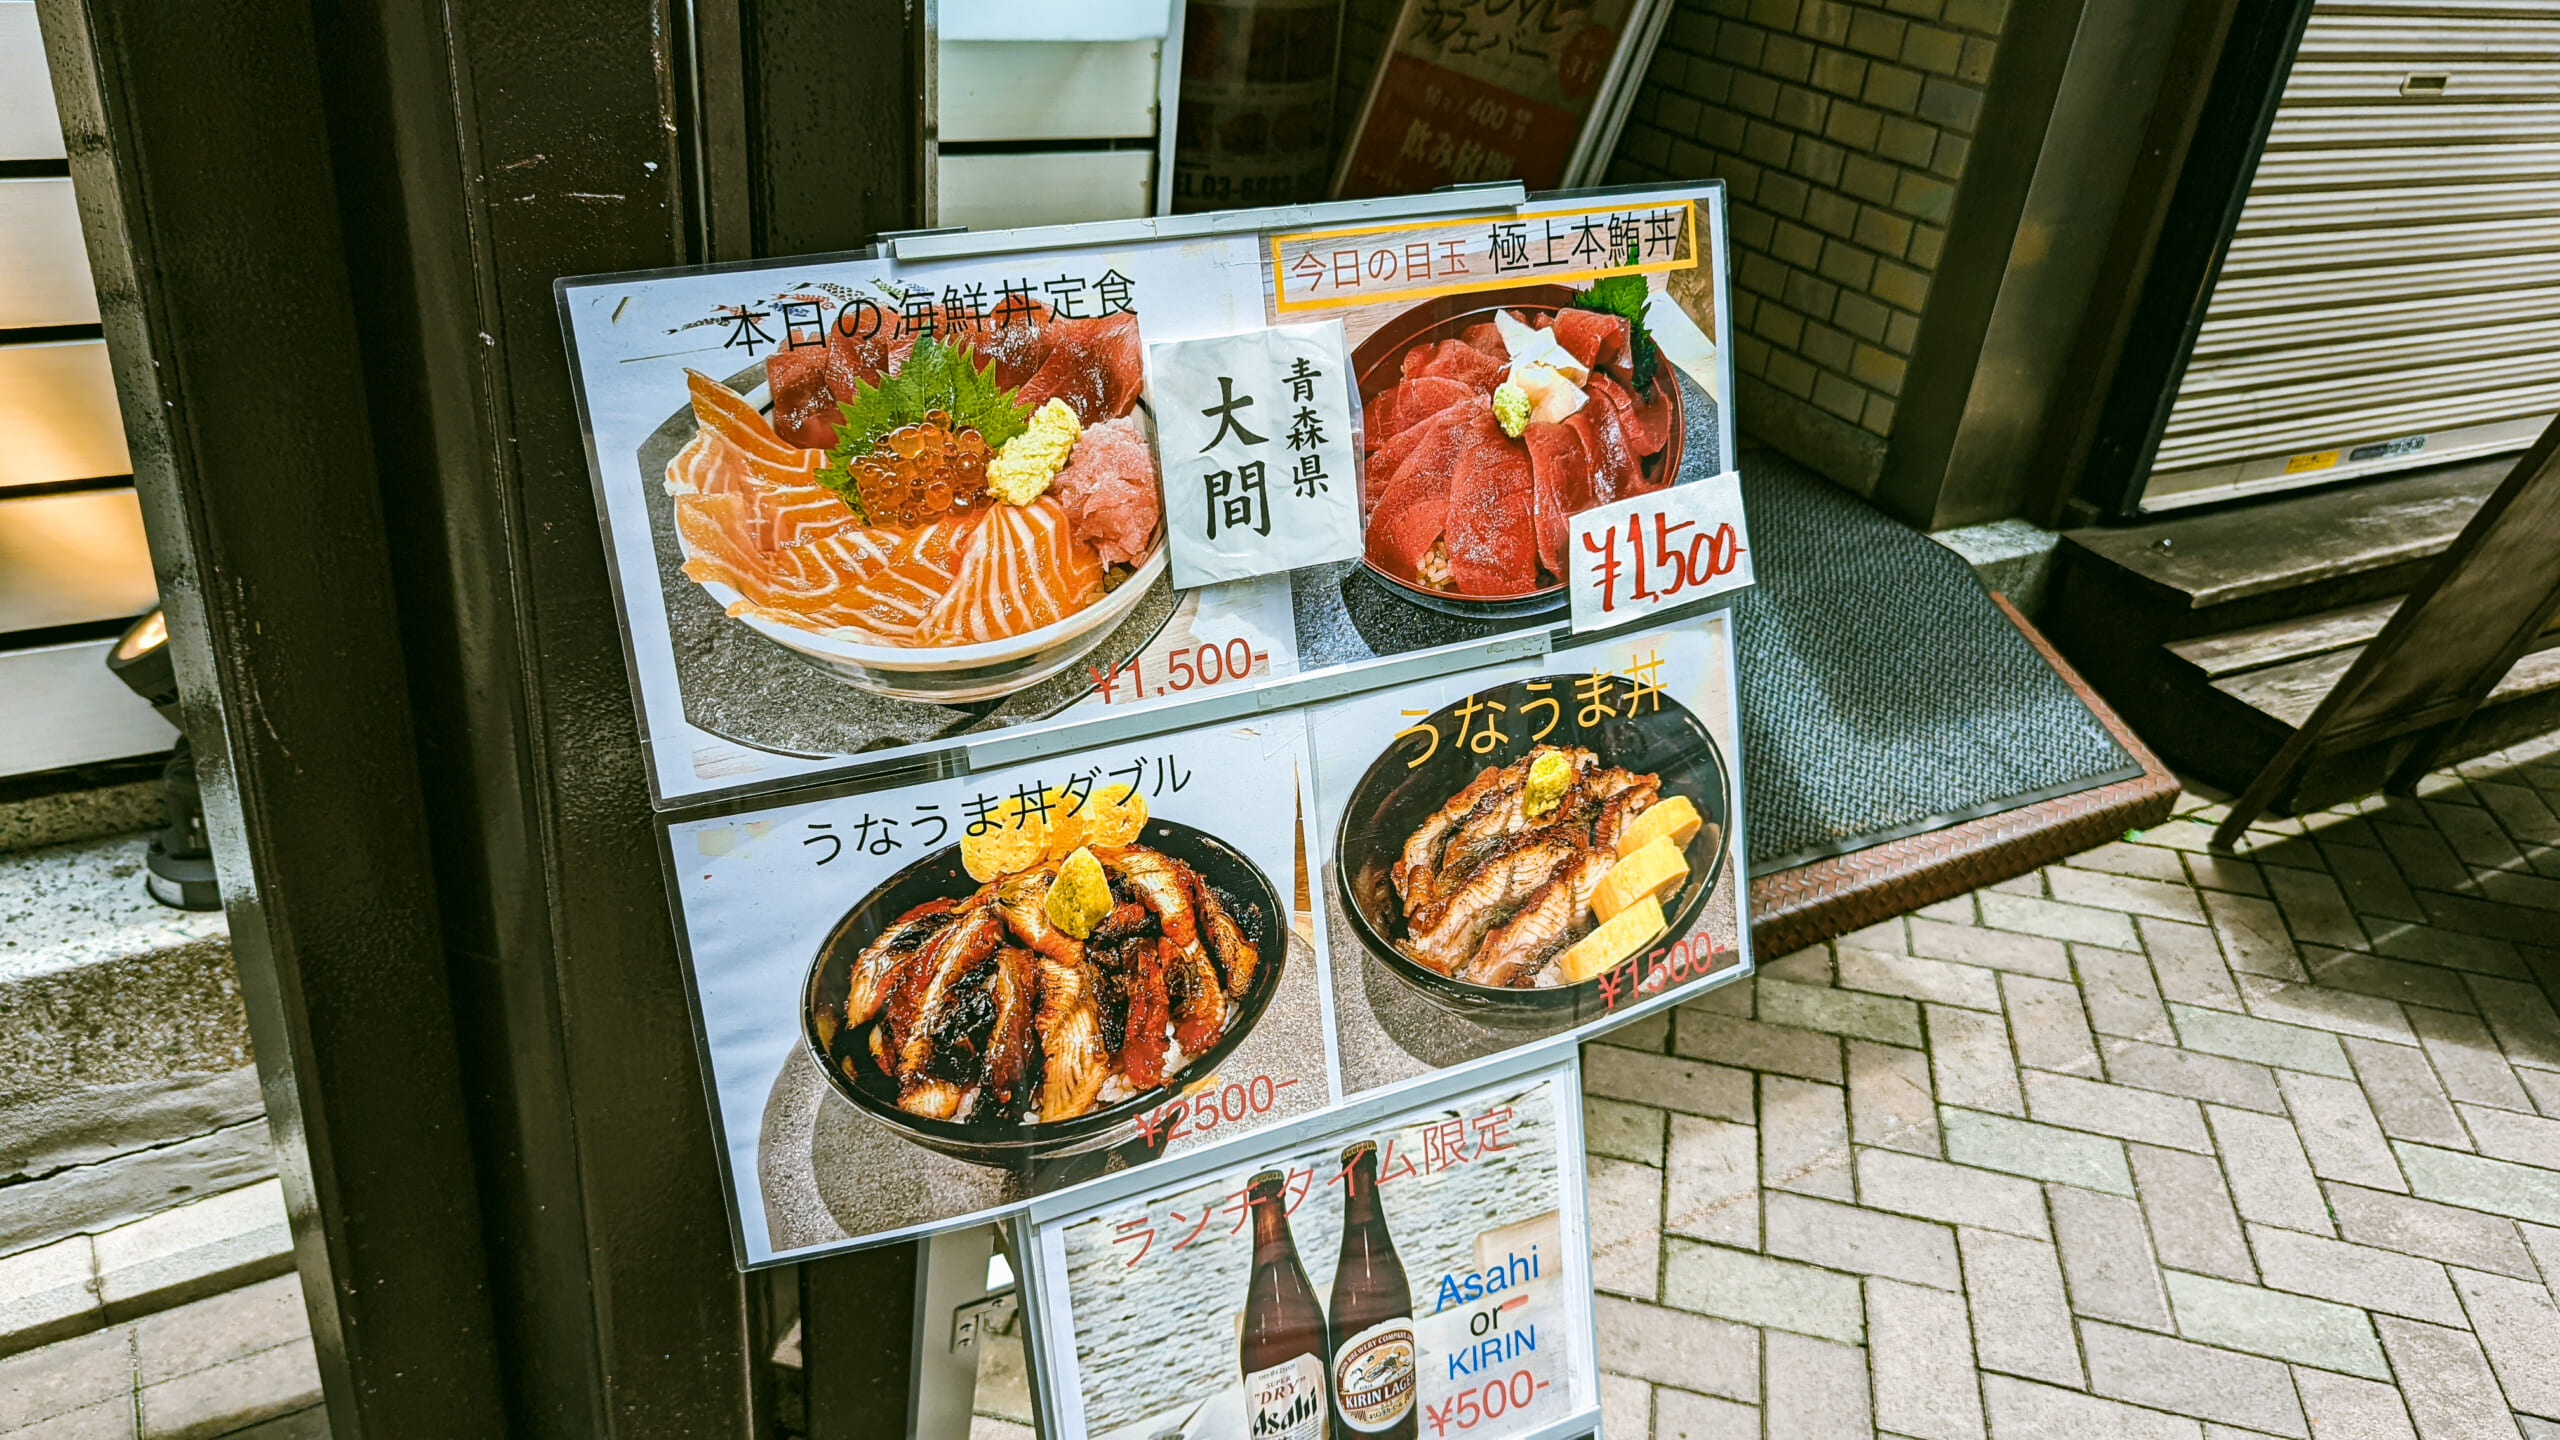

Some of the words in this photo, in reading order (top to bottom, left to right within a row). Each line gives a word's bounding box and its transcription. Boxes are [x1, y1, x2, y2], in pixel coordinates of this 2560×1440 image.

[1291, 240, 1470, 292] 今日の目玉
[1488, 209, 1677, 275] 極上本鮪丼
[723, 268, 1139, 357] 本日の海鮮丼定食
[1198, 376, 1271, 540] 大間
[1282, 357, 1328, 498] 青森県
[1089, 637, 1269, 703] ¥1,500-
[1394, 649, 1669, 769] うなうま丼
[803, 754, 1192, 866] うなうま丼ダブル
[1597, 932, 1725, 1009] ¥1500-
[1133, 1075, 1298, 1147] ¥2500-
[1112, 1107, 1515, 1267] ランチタイム限定
[1436, 1244, 1538, 1313] Asahi
[1449, 1324, 1536, 1380] KIRIN
[1470, 1306, 1503, 1336] or
[1253, 1386, 1317, 1436] Asahi
[1266, 1376, 1291, 1389] SUPER
[1346, 1389, 1382, 1409] KIRIN
[1425, 1370, 1549, 1437] ¥500-
